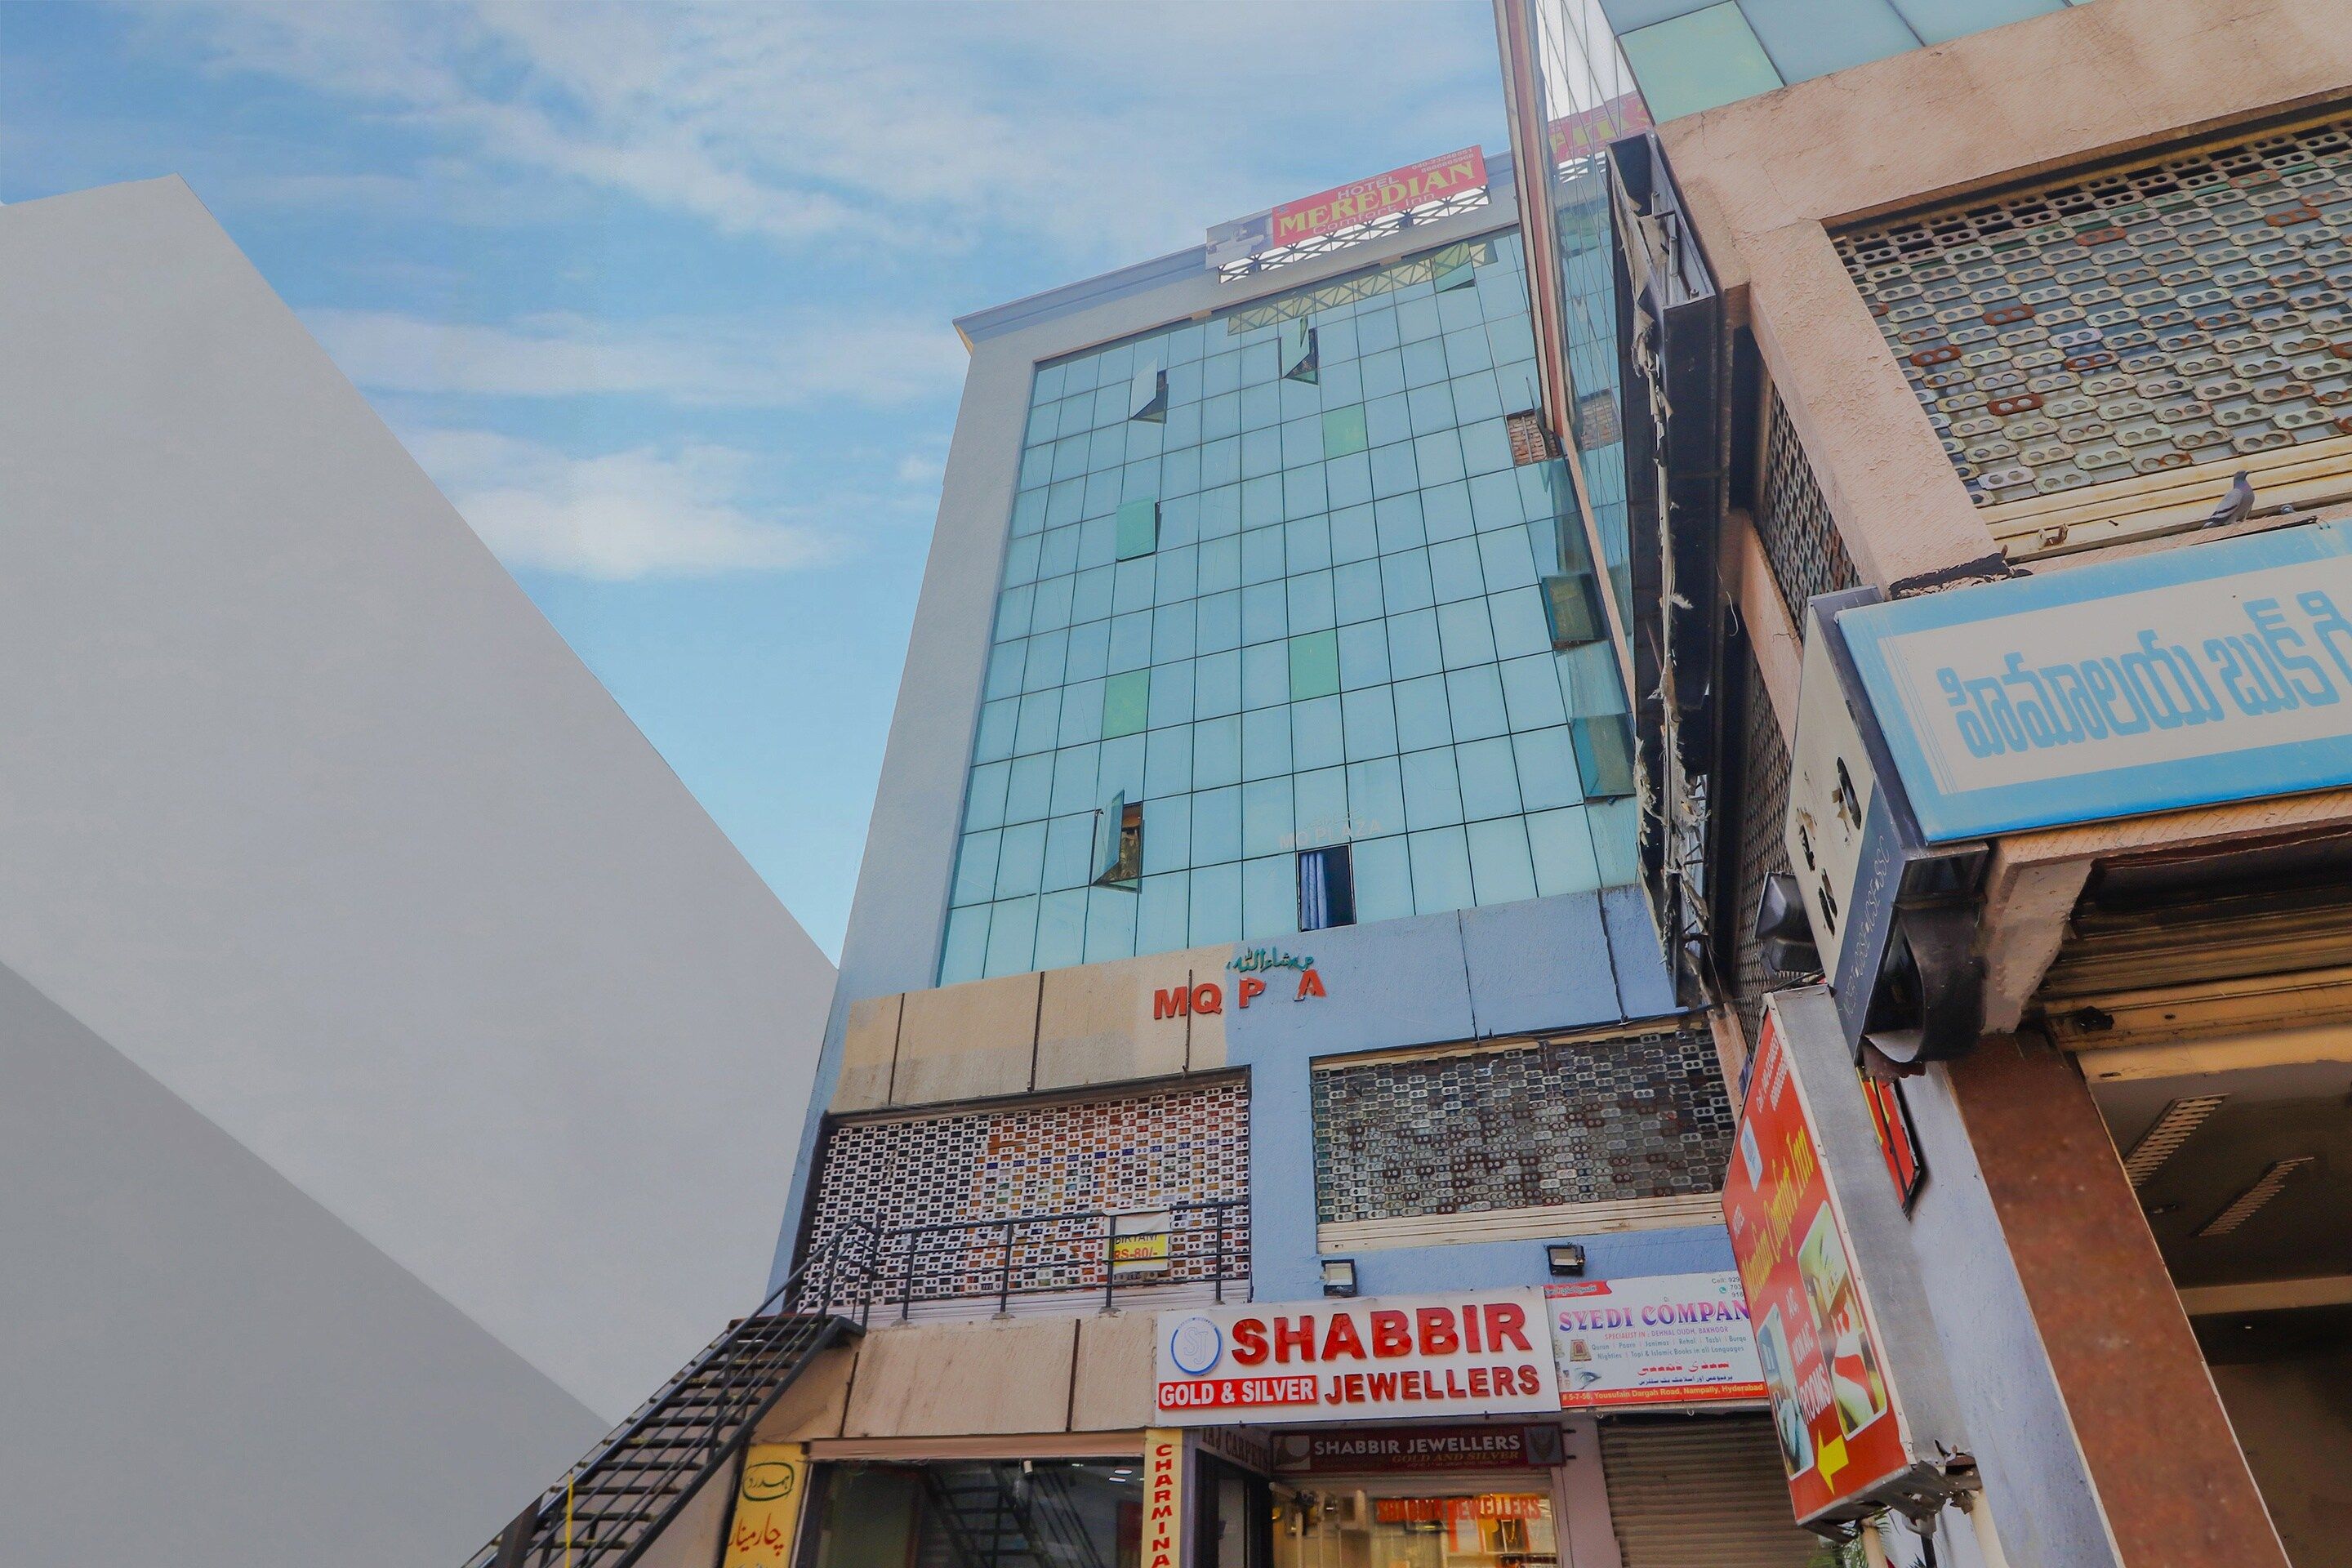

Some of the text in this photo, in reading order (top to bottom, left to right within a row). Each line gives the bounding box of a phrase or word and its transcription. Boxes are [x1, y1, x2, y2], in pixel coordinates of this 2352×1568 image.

[1279, 162, 1476, 238] MEREDIAN
[1337, 175, 1400, 199] HOTEL
[1313, 205, 1397, 234] Comfort
[1405, 194, 1435, 207] Inn
[1153, 982, 1223, 1019] MQ
[1558, 1307, 1634, 1333] SYEDI
[1232, 1303, 1532, 1365] SHABBIR
[1604, 1332, 1637, 1340] SPECIALIST
[1711, 1345, 1744, 1353] Languages
[1160, 1378, 1315, 1407] GOLD & SILVER
[1325, 1365, 1540, 1405] JEWELLERS
[1594, 1390, 1630, 1399] Yousufain
[1631, 1388, 1659, 1398] Dargah
[1659, 1388, 1682, 1396] Road,
[1684, 1386, 1721, 1396] Nampally,
[1722, 1383, 1763, 1392] Hyderabad
[1799, 1362, 1831, 1424] ROOMS
[1314, 1435, 1521, 1455] SHABBIR JEWELLERS
[1393, 1452, 1432, 1463] GOLD
[1435, 1451, 1463, 1462] AND
[1467, 1450, 1519, 1461] SILVER
[1447, 1496, 1541, 1521] JEWELLERS
